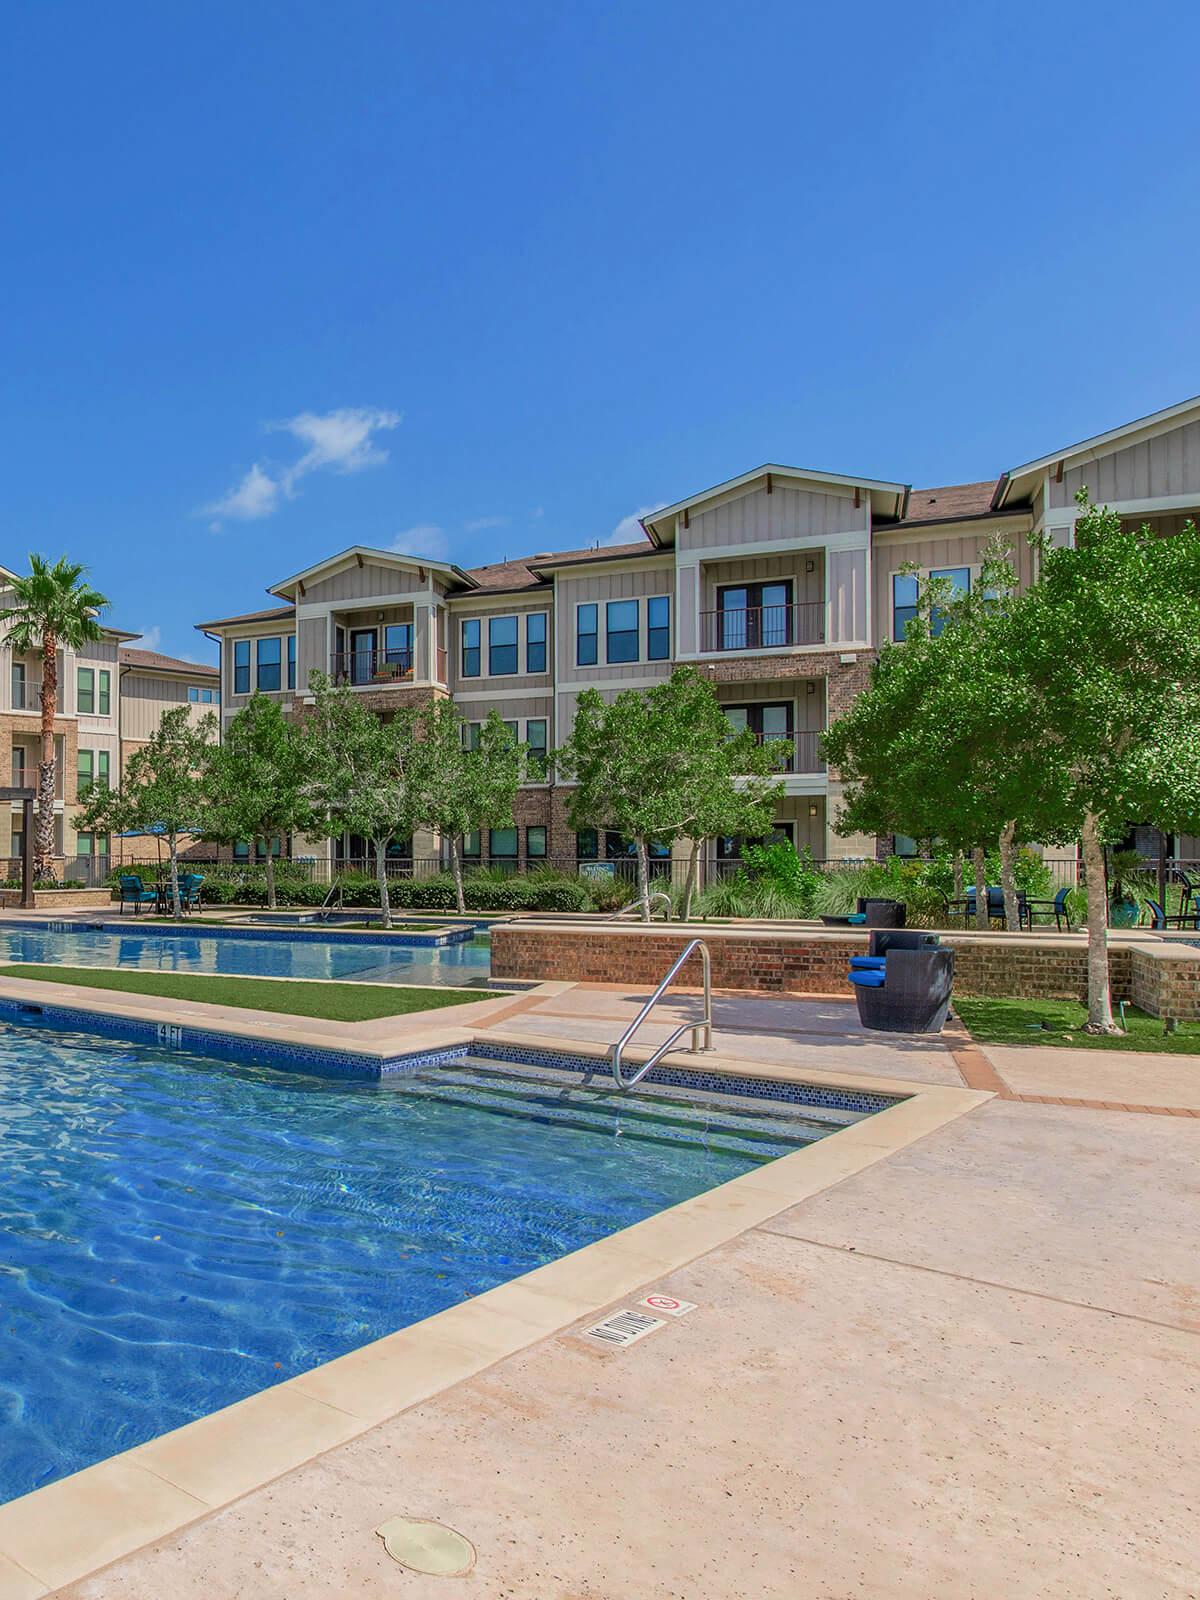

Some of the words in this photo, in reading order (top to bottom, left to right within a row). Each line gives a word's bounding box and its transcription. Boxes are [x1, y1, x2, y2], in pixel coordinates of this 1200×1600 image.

[160, 1024, 167, 1037] 4
[170, 1025, 181, 1039] FT
[603, 1311, 659, 1335] DIVING
[588, 1327, 628, 1345] NO
